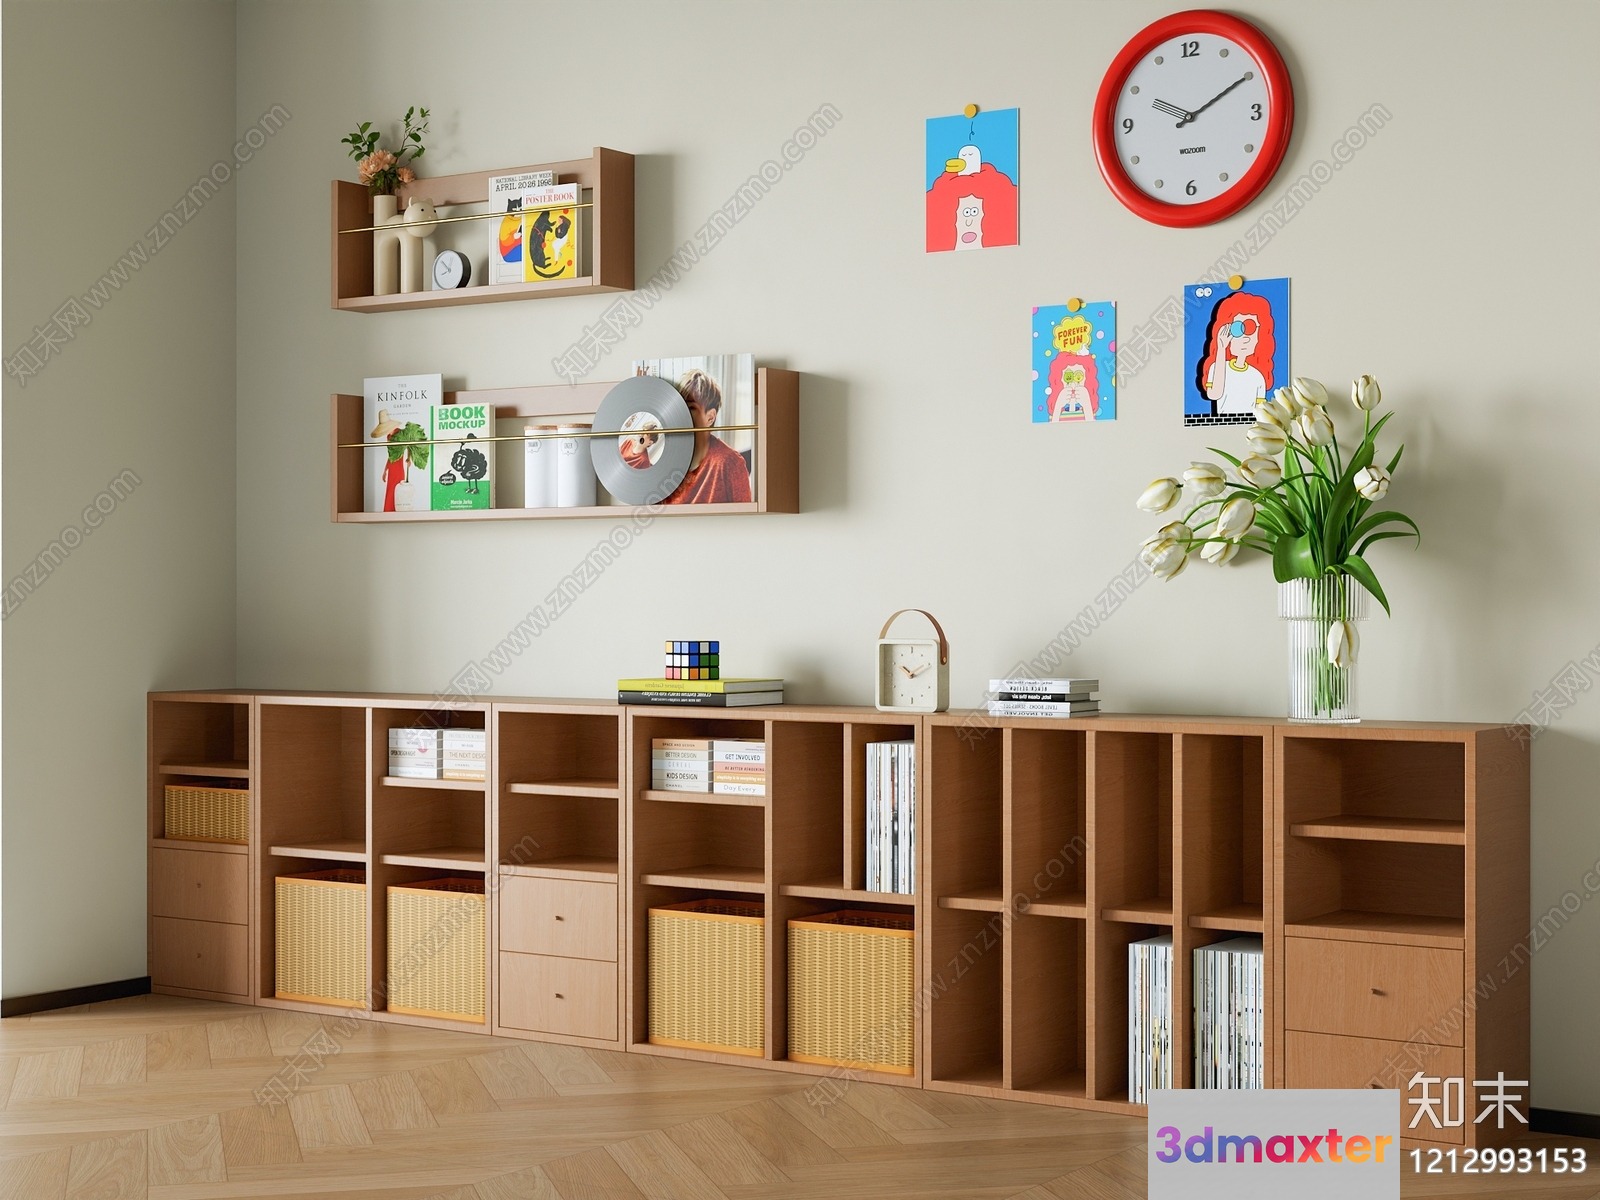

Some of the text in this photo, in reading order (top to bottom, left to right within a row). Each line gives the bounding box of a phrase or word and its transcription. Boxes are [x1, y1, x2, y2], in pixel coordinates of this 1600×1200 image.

[1180, 41, 1200, 58] 12
[1250, 103, 1262, 121] 3
[1122, 118, 1134, 134] 9
[1179, 146, 1206, 155] wozoom
[495, 176, 517, 184] NATIONAL
[519, 174, 538, 182] LIBRARY
[495, 182, 517, 192] APRIL
[1185, 179, 1198, 196] 6
[525, 194, 553, 205] POSTER
[553, 192, 574, 200] BOOK
[1058, 325, 1088, 341] FOREVER
[1063, 335, 1083, 348] FUN
[377, 390, 428, 402] KINFOLK
[438, 405, 486, 420] BOOK
[438, 420, 486, 430] MOCKUP
[724, 785, 737, 793] Day
